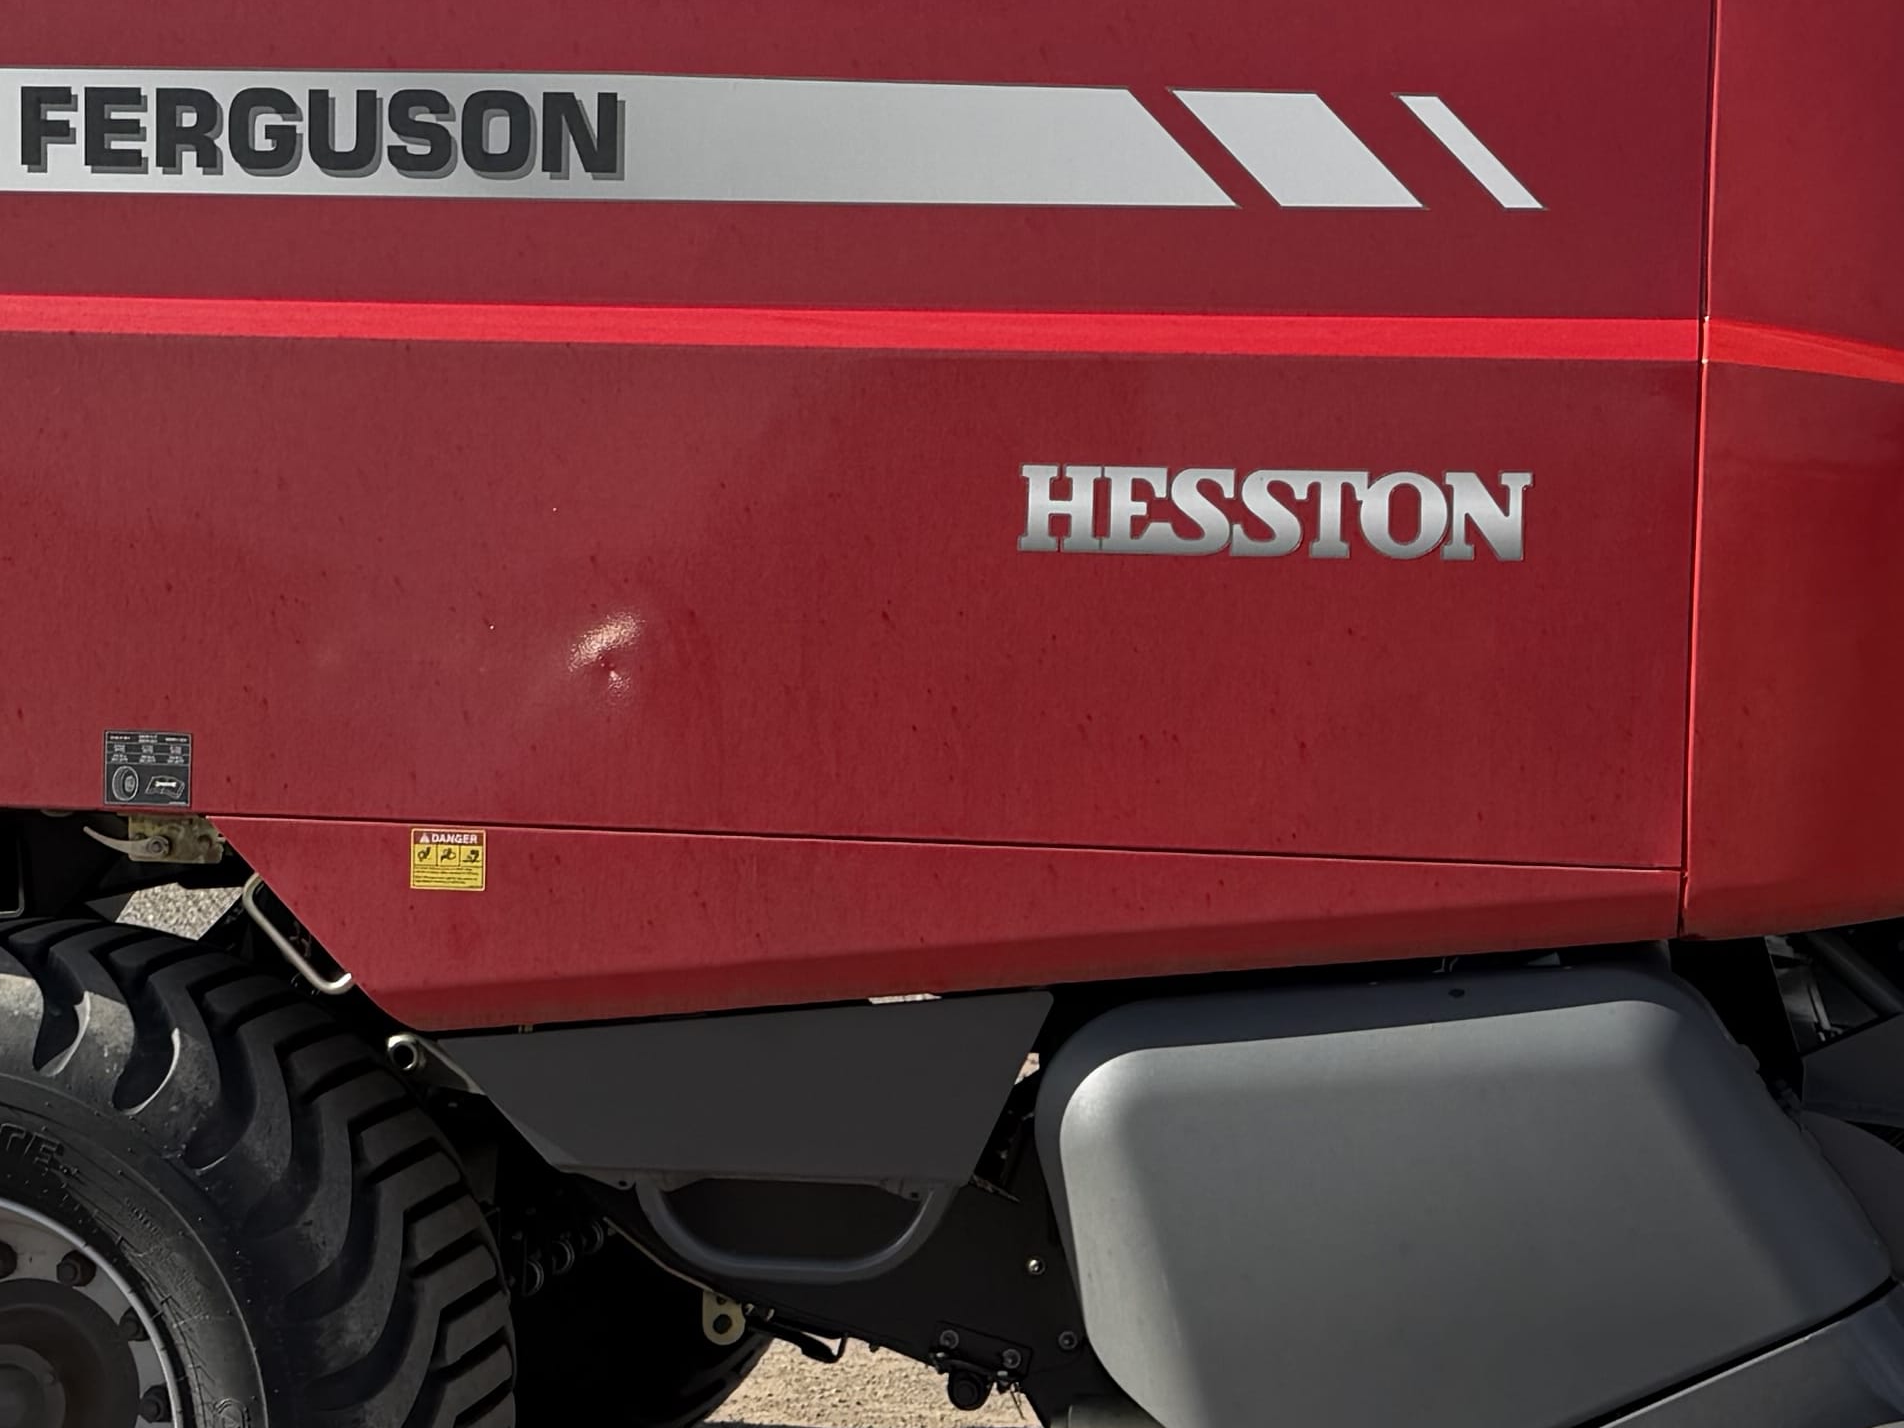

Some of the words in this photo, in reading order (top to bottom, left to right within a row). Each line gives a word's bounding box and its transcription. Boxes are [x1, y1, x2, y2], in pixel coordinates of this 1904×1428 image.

[20, 85, 626, 180] FERGUSON
[1017, 463, 1534, 562] HESSTON
[431, 833, 478, 845] DANGER
